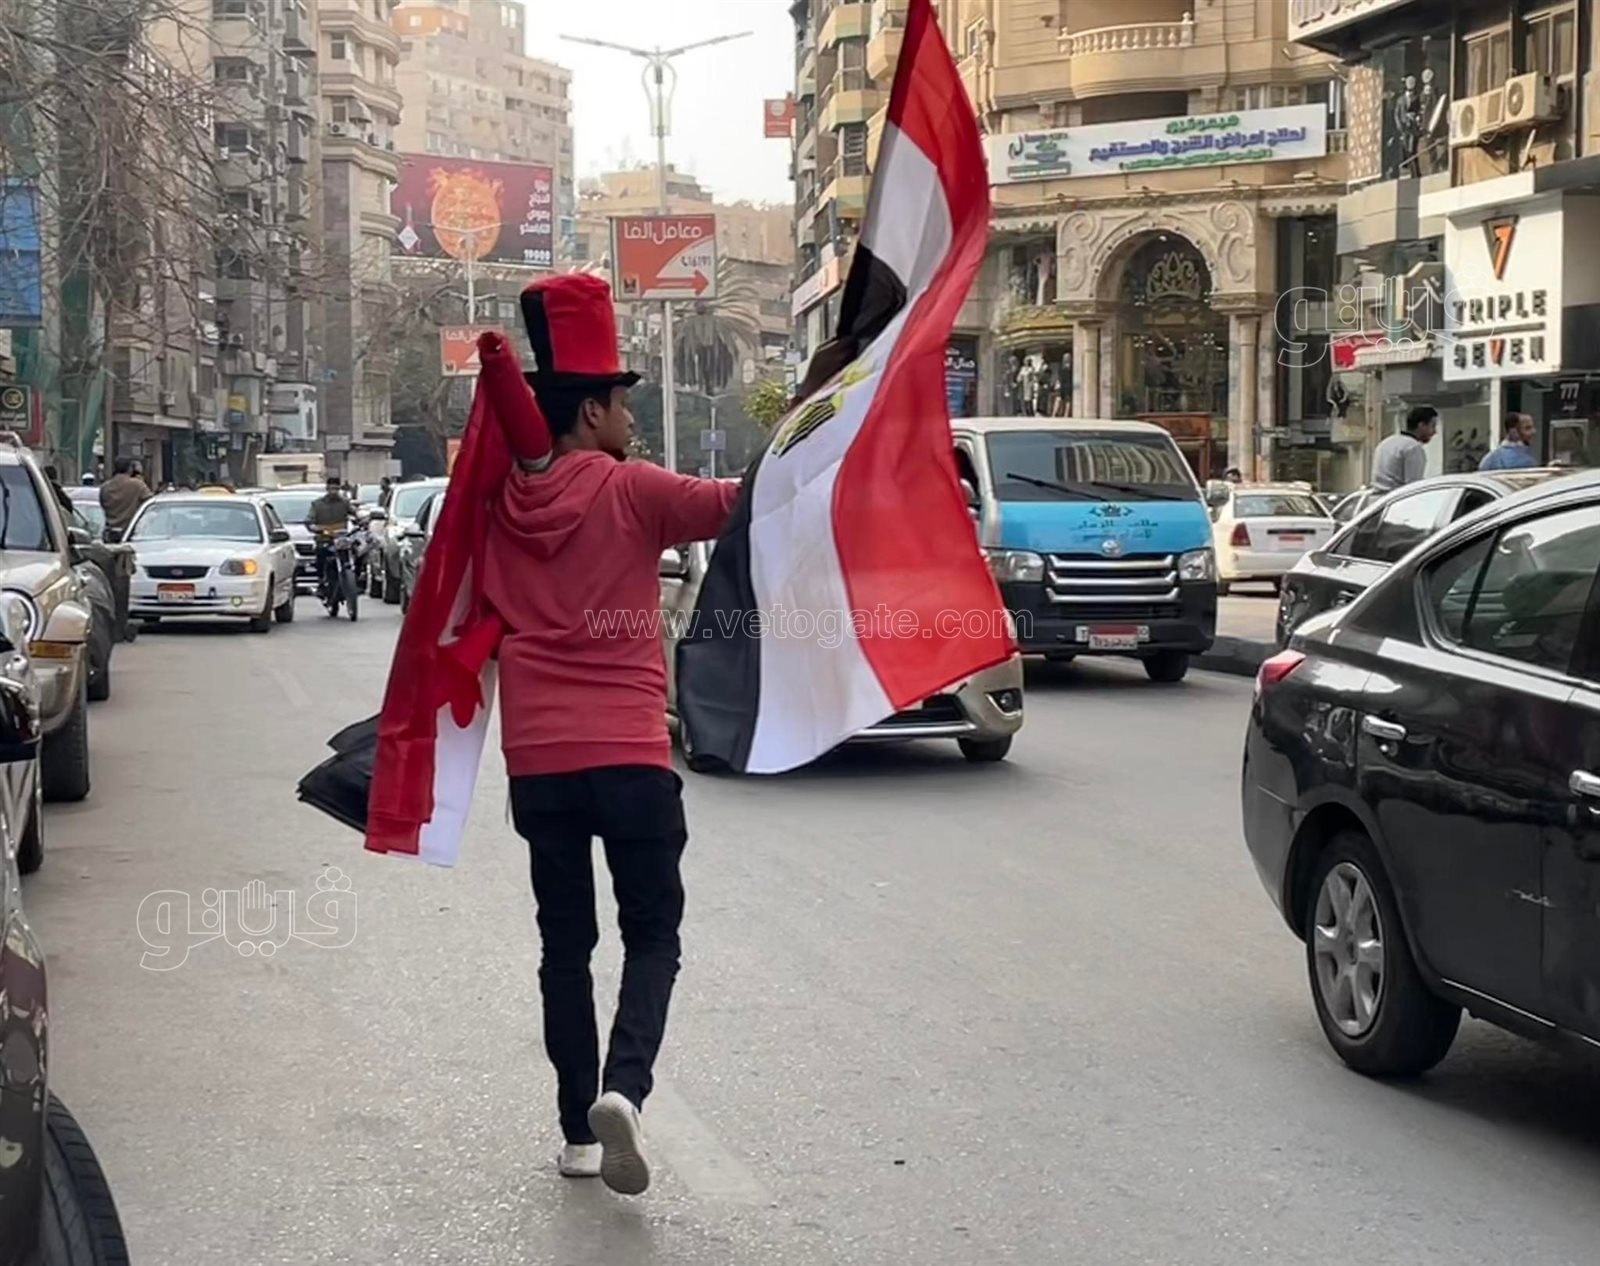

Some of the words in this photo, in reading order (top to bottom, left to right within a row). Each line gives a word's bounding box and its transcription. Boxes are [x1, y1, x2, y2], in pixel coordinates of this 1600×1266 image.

[653, 221, 702, 245] معامل
[1452, 289, 1548, 325] TRIPLE
[1453, 336, 1545, 370] SEVEN
